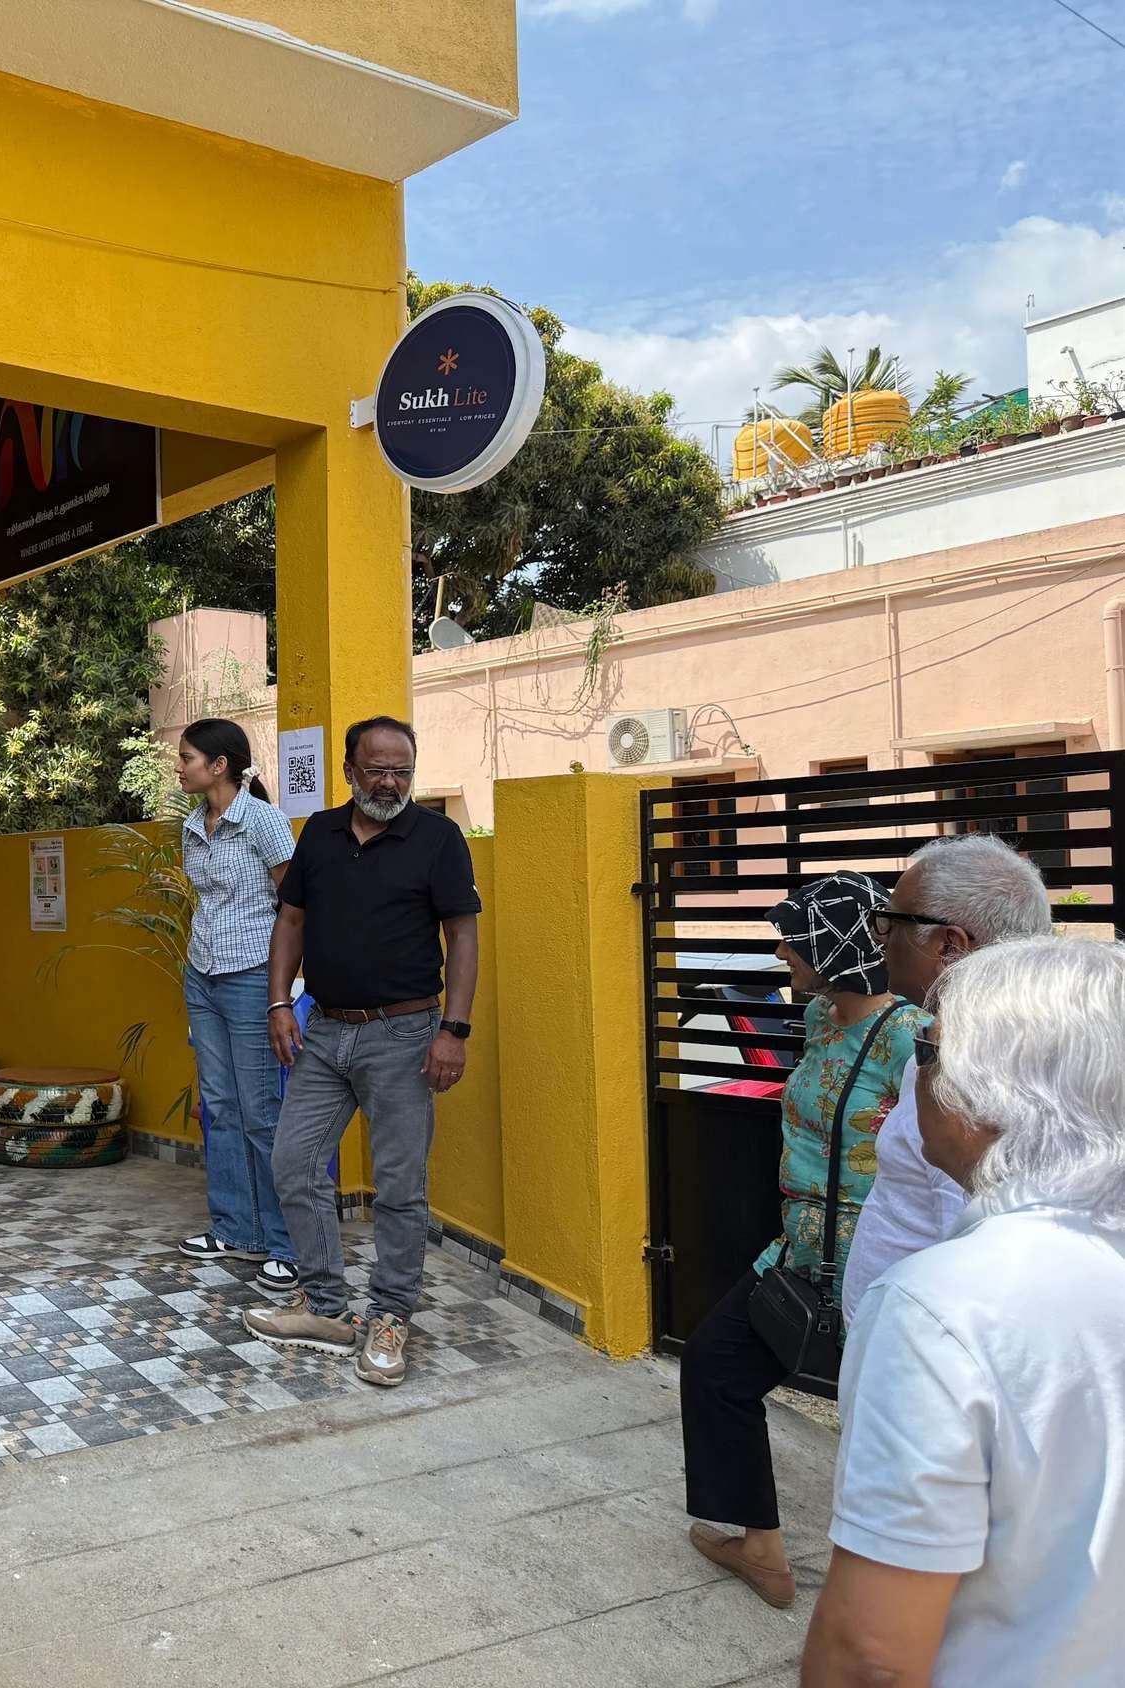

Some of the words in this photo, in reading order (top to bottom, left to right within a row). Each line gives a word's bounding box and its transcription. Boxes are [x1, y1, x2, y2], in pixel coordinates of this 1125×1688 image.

[399, 388, 449, 411] Sukh
[453, 386, 488, 407] Lite
[20, 543, 38, 558] WHERE
[76, 521, 94, 536] HOME
